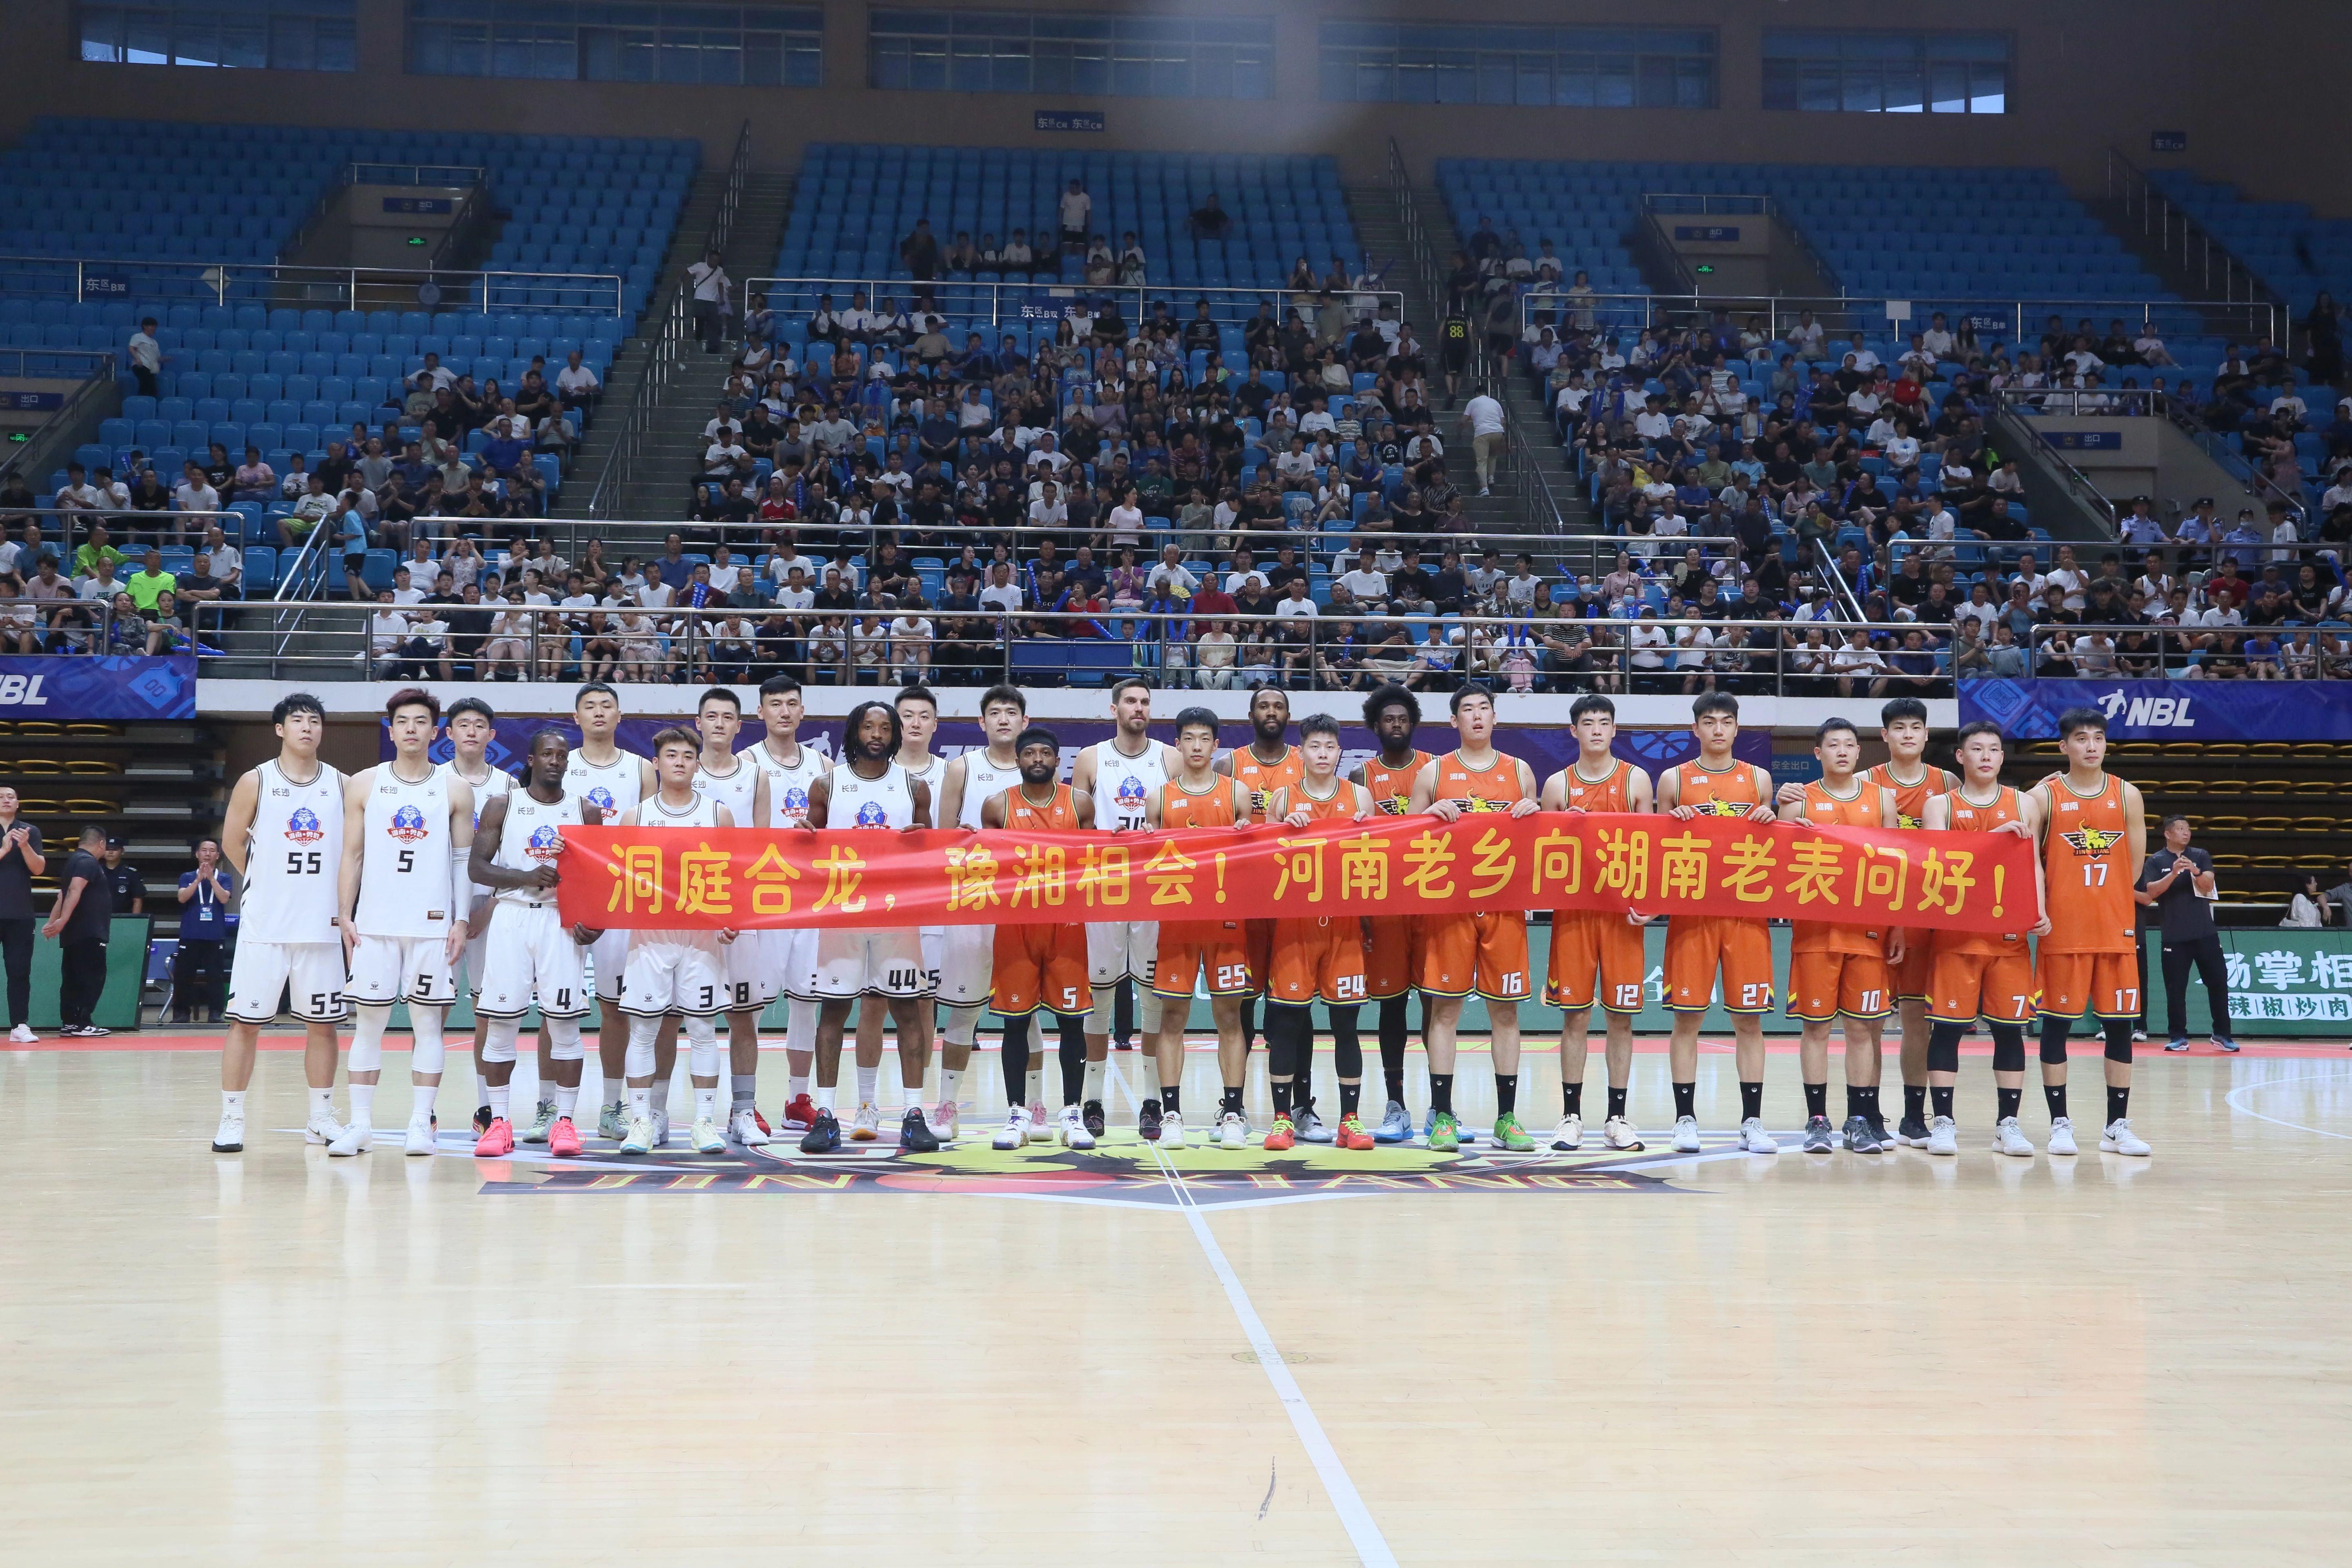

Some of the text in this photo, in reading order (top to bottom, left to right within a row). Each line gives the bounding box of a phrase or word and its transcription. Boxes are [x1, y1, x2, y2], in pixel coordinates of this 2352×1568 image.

[1450, 326, 1464, 338] 88
[21, 394, 38, 403] 出口
[0, 675, 48, 705] BL
[2125, 697, 2195, 727] NBL
[1243, 766, 1258, 774] 河南
[1772, 761, 1809, 770] 安全出口
[1691, 776, 1708, 785] 河南
[1016, 808, 1031, 817] 河南
[1172, 799, 1187, 809] 河南
[1295, 803, 1312, 811] 河南
[1816, 802, 1833, 811] 河南
[1956, 810, 1973, 819] 河南
[2061, 802, 2078, 812] 河南
[287, 852, 321, 874] 55
[397, 850, 414, 873] 5
[2083, 863, 2108, 886] 17
[415, 974, 433, 996] 5
[888, 969, 917, 990] 44
[1217, 964, 1245, 989] 25
[1336, 974, 1365, 998] 24
[1501, 971, 1522, 995] 16
[311, 991, 341, 1015] 55
[557, 988, 571, 1010] 4
[699, 985, 713, 1008] 3
[735, 982, 749, 1004] 8
[1062, 987, 1077, 1009] 5
[1615, 984, 1639, 1006] 12
[1742, 983, 1769, 1006] 27
[1860, 989, 1881, 1012] 10
[2115, 988, 2138, 1011] 17
[2012, 995, 2026, 1018] 7
[537, 1173, 1637, 1190] JIN XIANG
